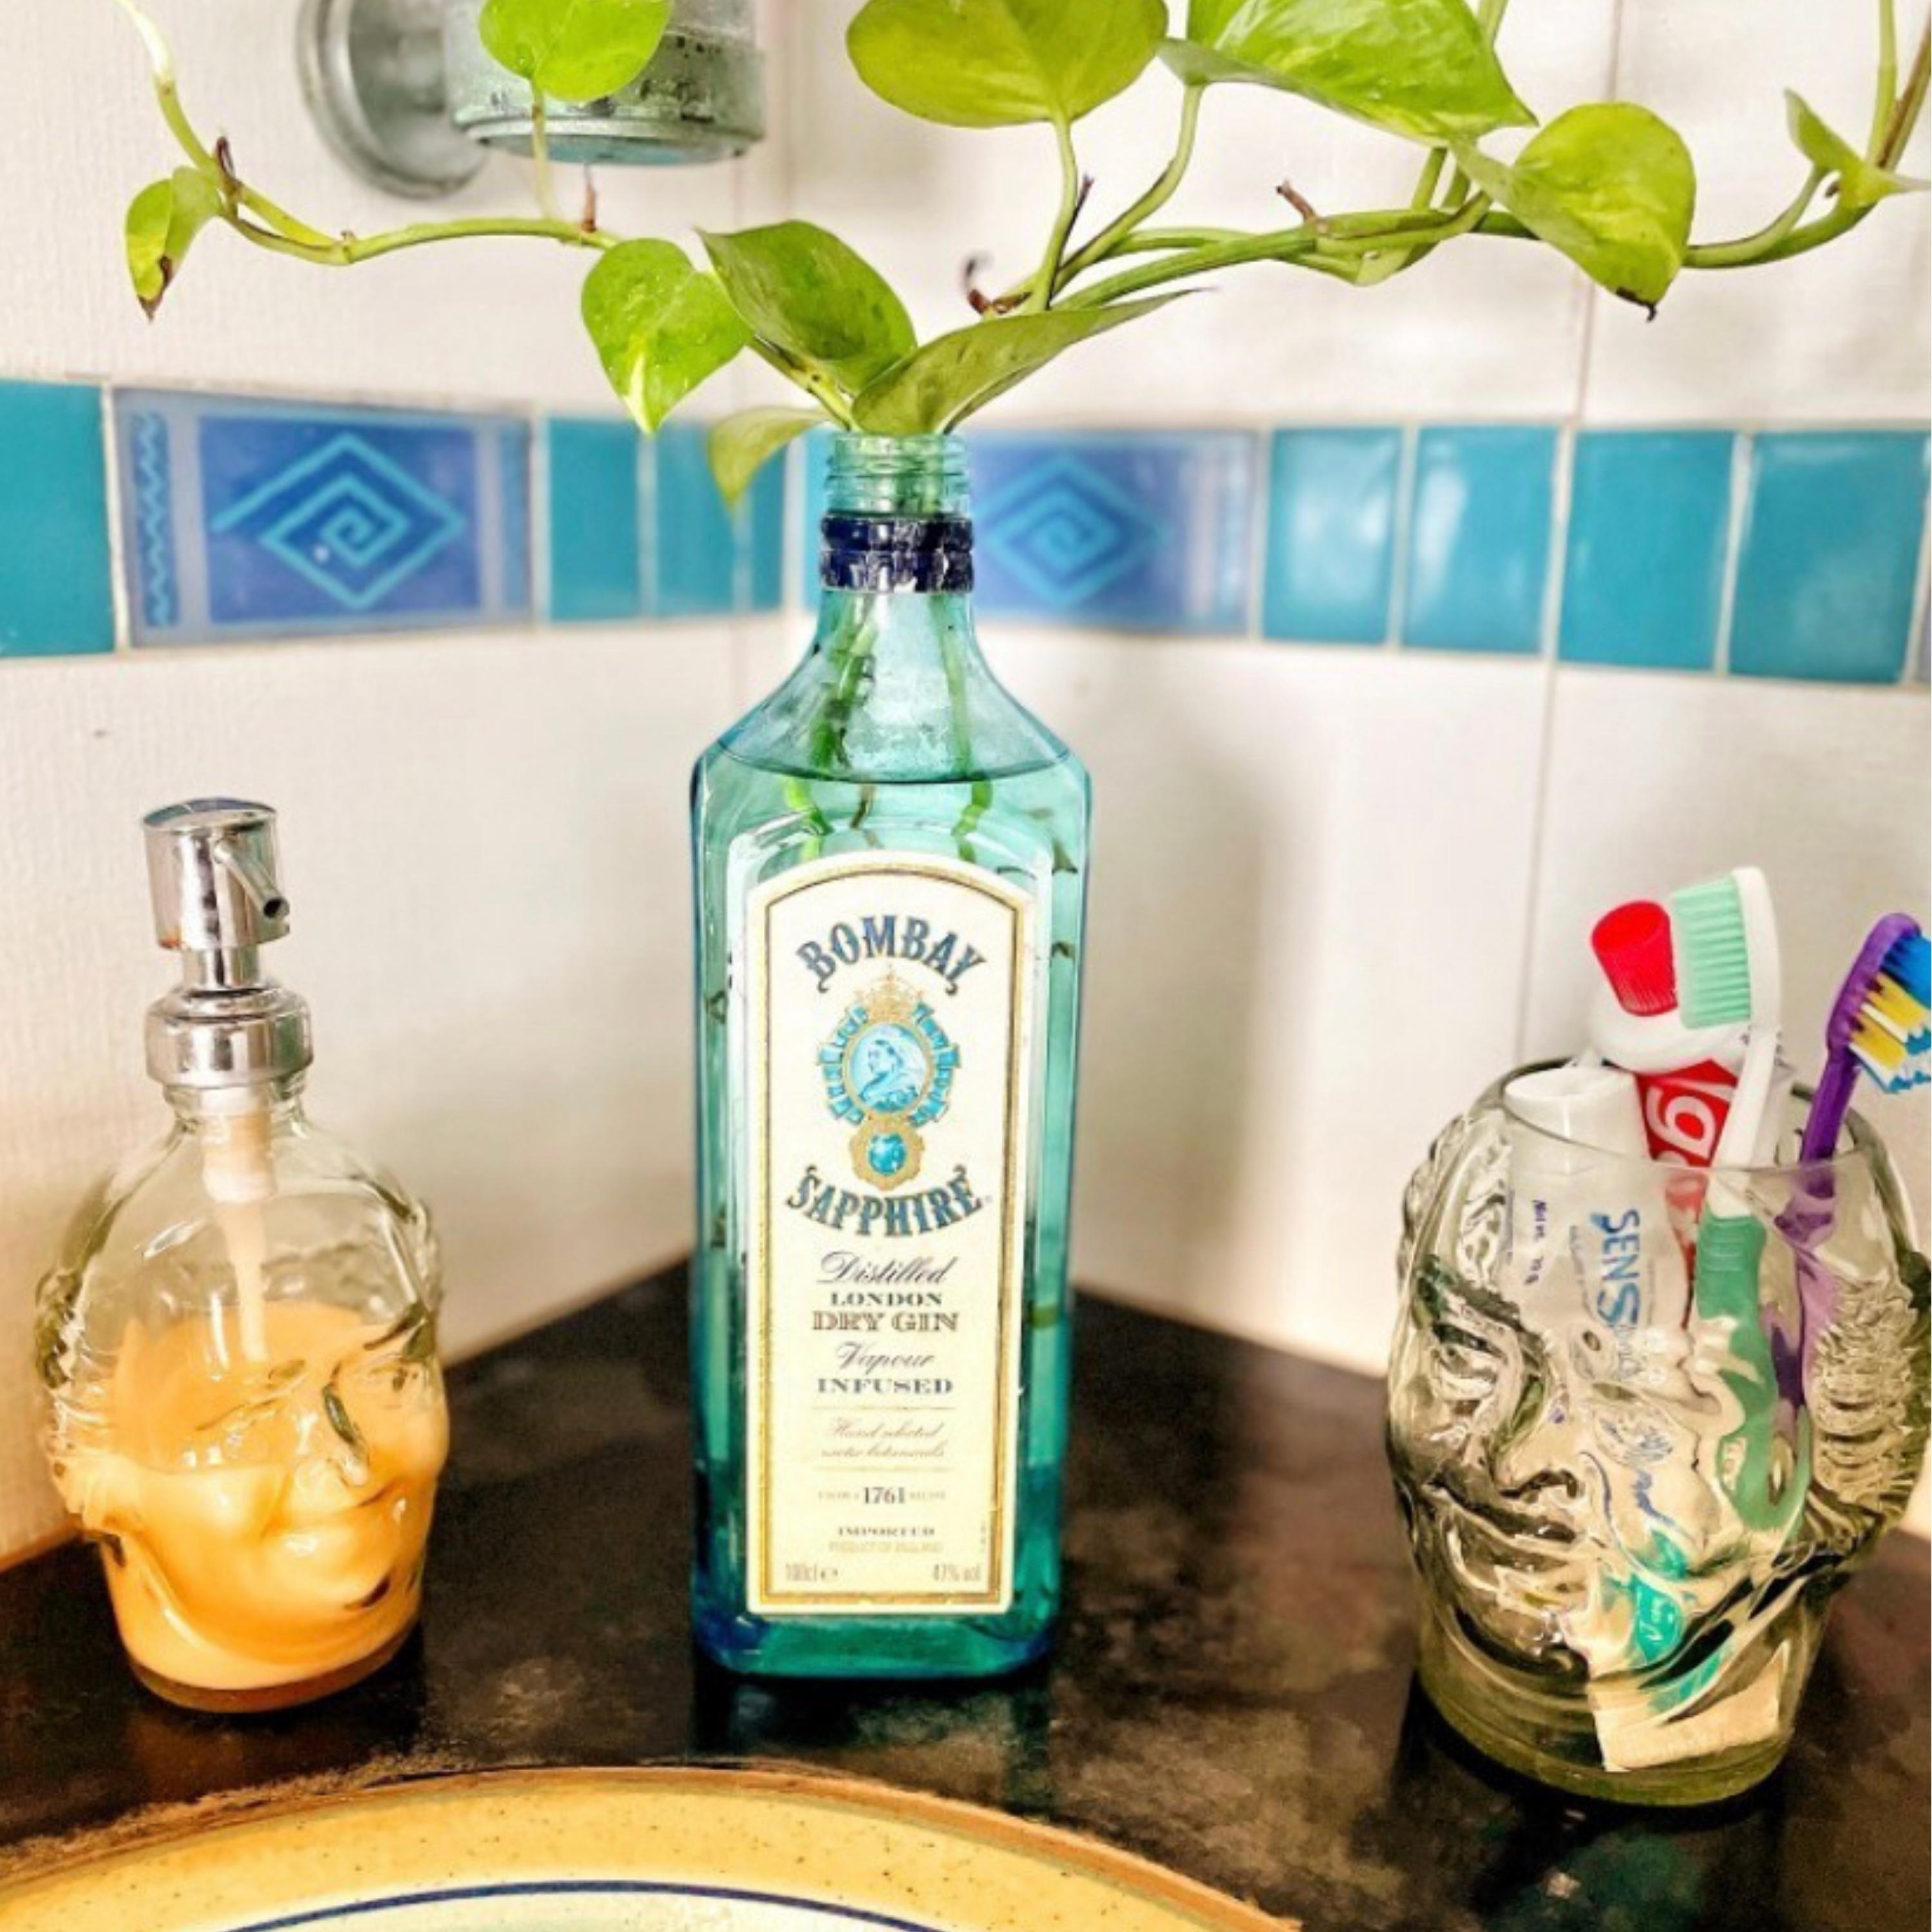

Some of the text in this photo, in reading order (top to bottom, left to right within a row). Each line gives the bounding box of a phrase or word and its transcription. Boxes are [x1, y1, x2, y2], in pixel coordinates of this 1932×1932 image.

[796, 914, 987, 995] BOMBAY
[786, 1164, 983, 1237] SAPPHIRE
[817, 1251, 958, 1283] Distilled
[831, 1292, 942, 1306] LONDON
[813, 1310, 958, 1331] DRY GIN
[819, 1378, 953, 1394] INFUSED
[864, 1486, 905, 1504] 1761
